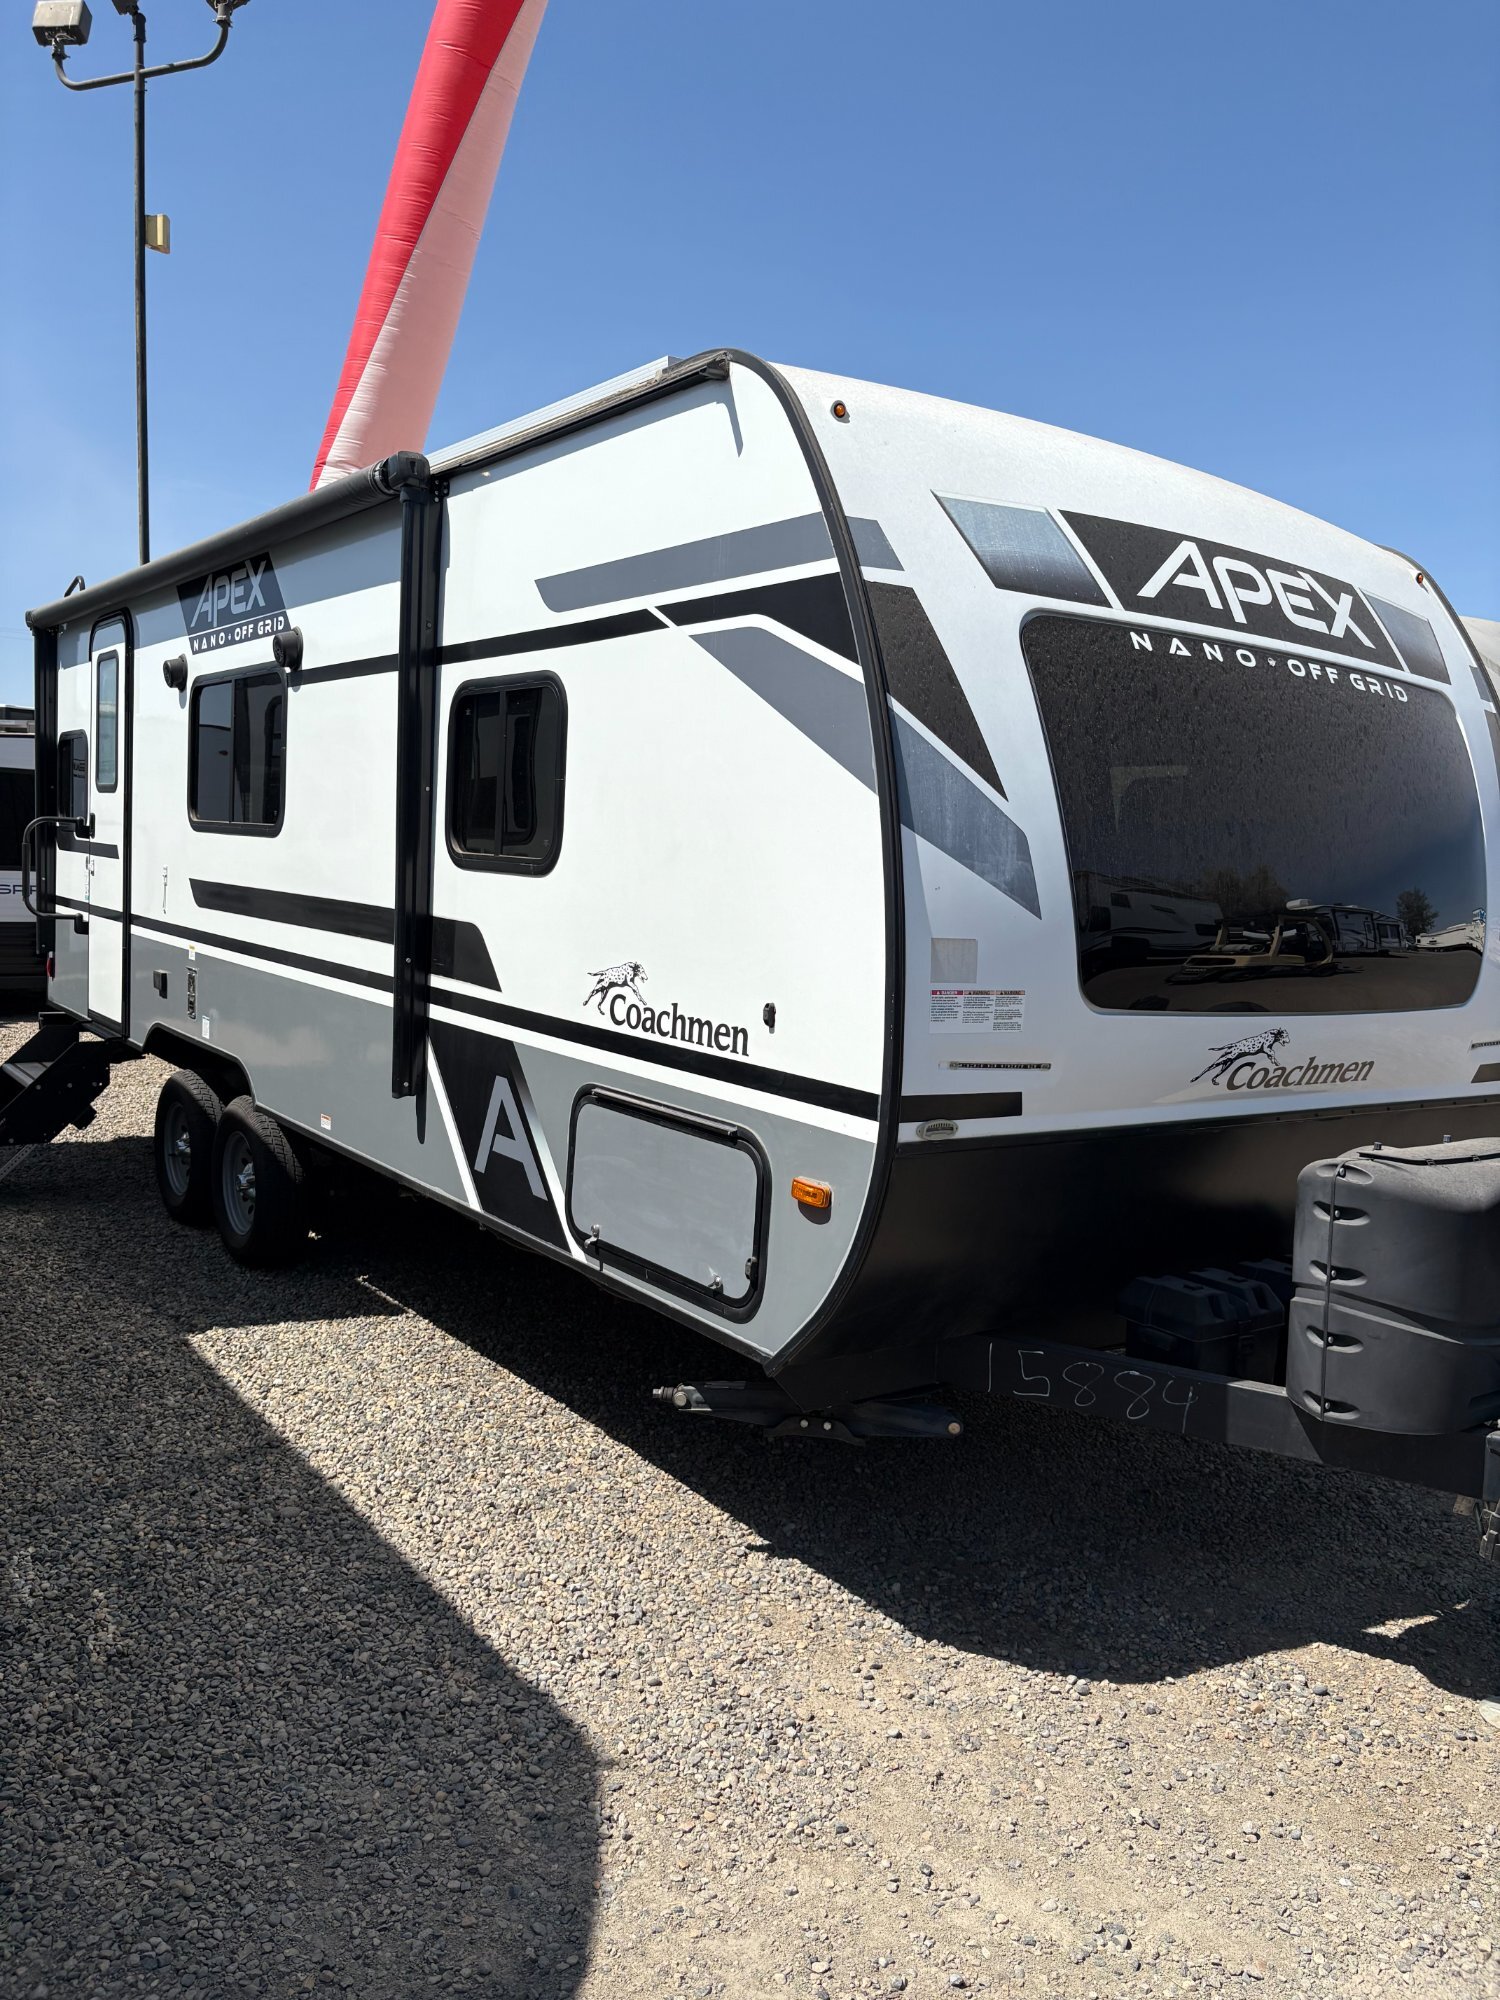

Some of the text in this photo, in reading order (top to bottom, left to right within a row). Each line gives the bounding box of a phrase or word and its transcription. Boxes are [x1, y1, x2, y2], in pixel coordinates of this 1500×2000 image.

[190, 560, 266, 628] APEX
[1136, 540, 1376, 649] APEX
[193, 616, 285, 652] NANO OFF GRID
[1129, 631, 1409, 703] NANO OFF GRID
[609, 993, 749, 1057] Coachmen
[1226, 1056, 1375, 1091] Coachmen
[474, 1075, 548, 1201] A
[987, 1342, 1200, 1434] 15884
